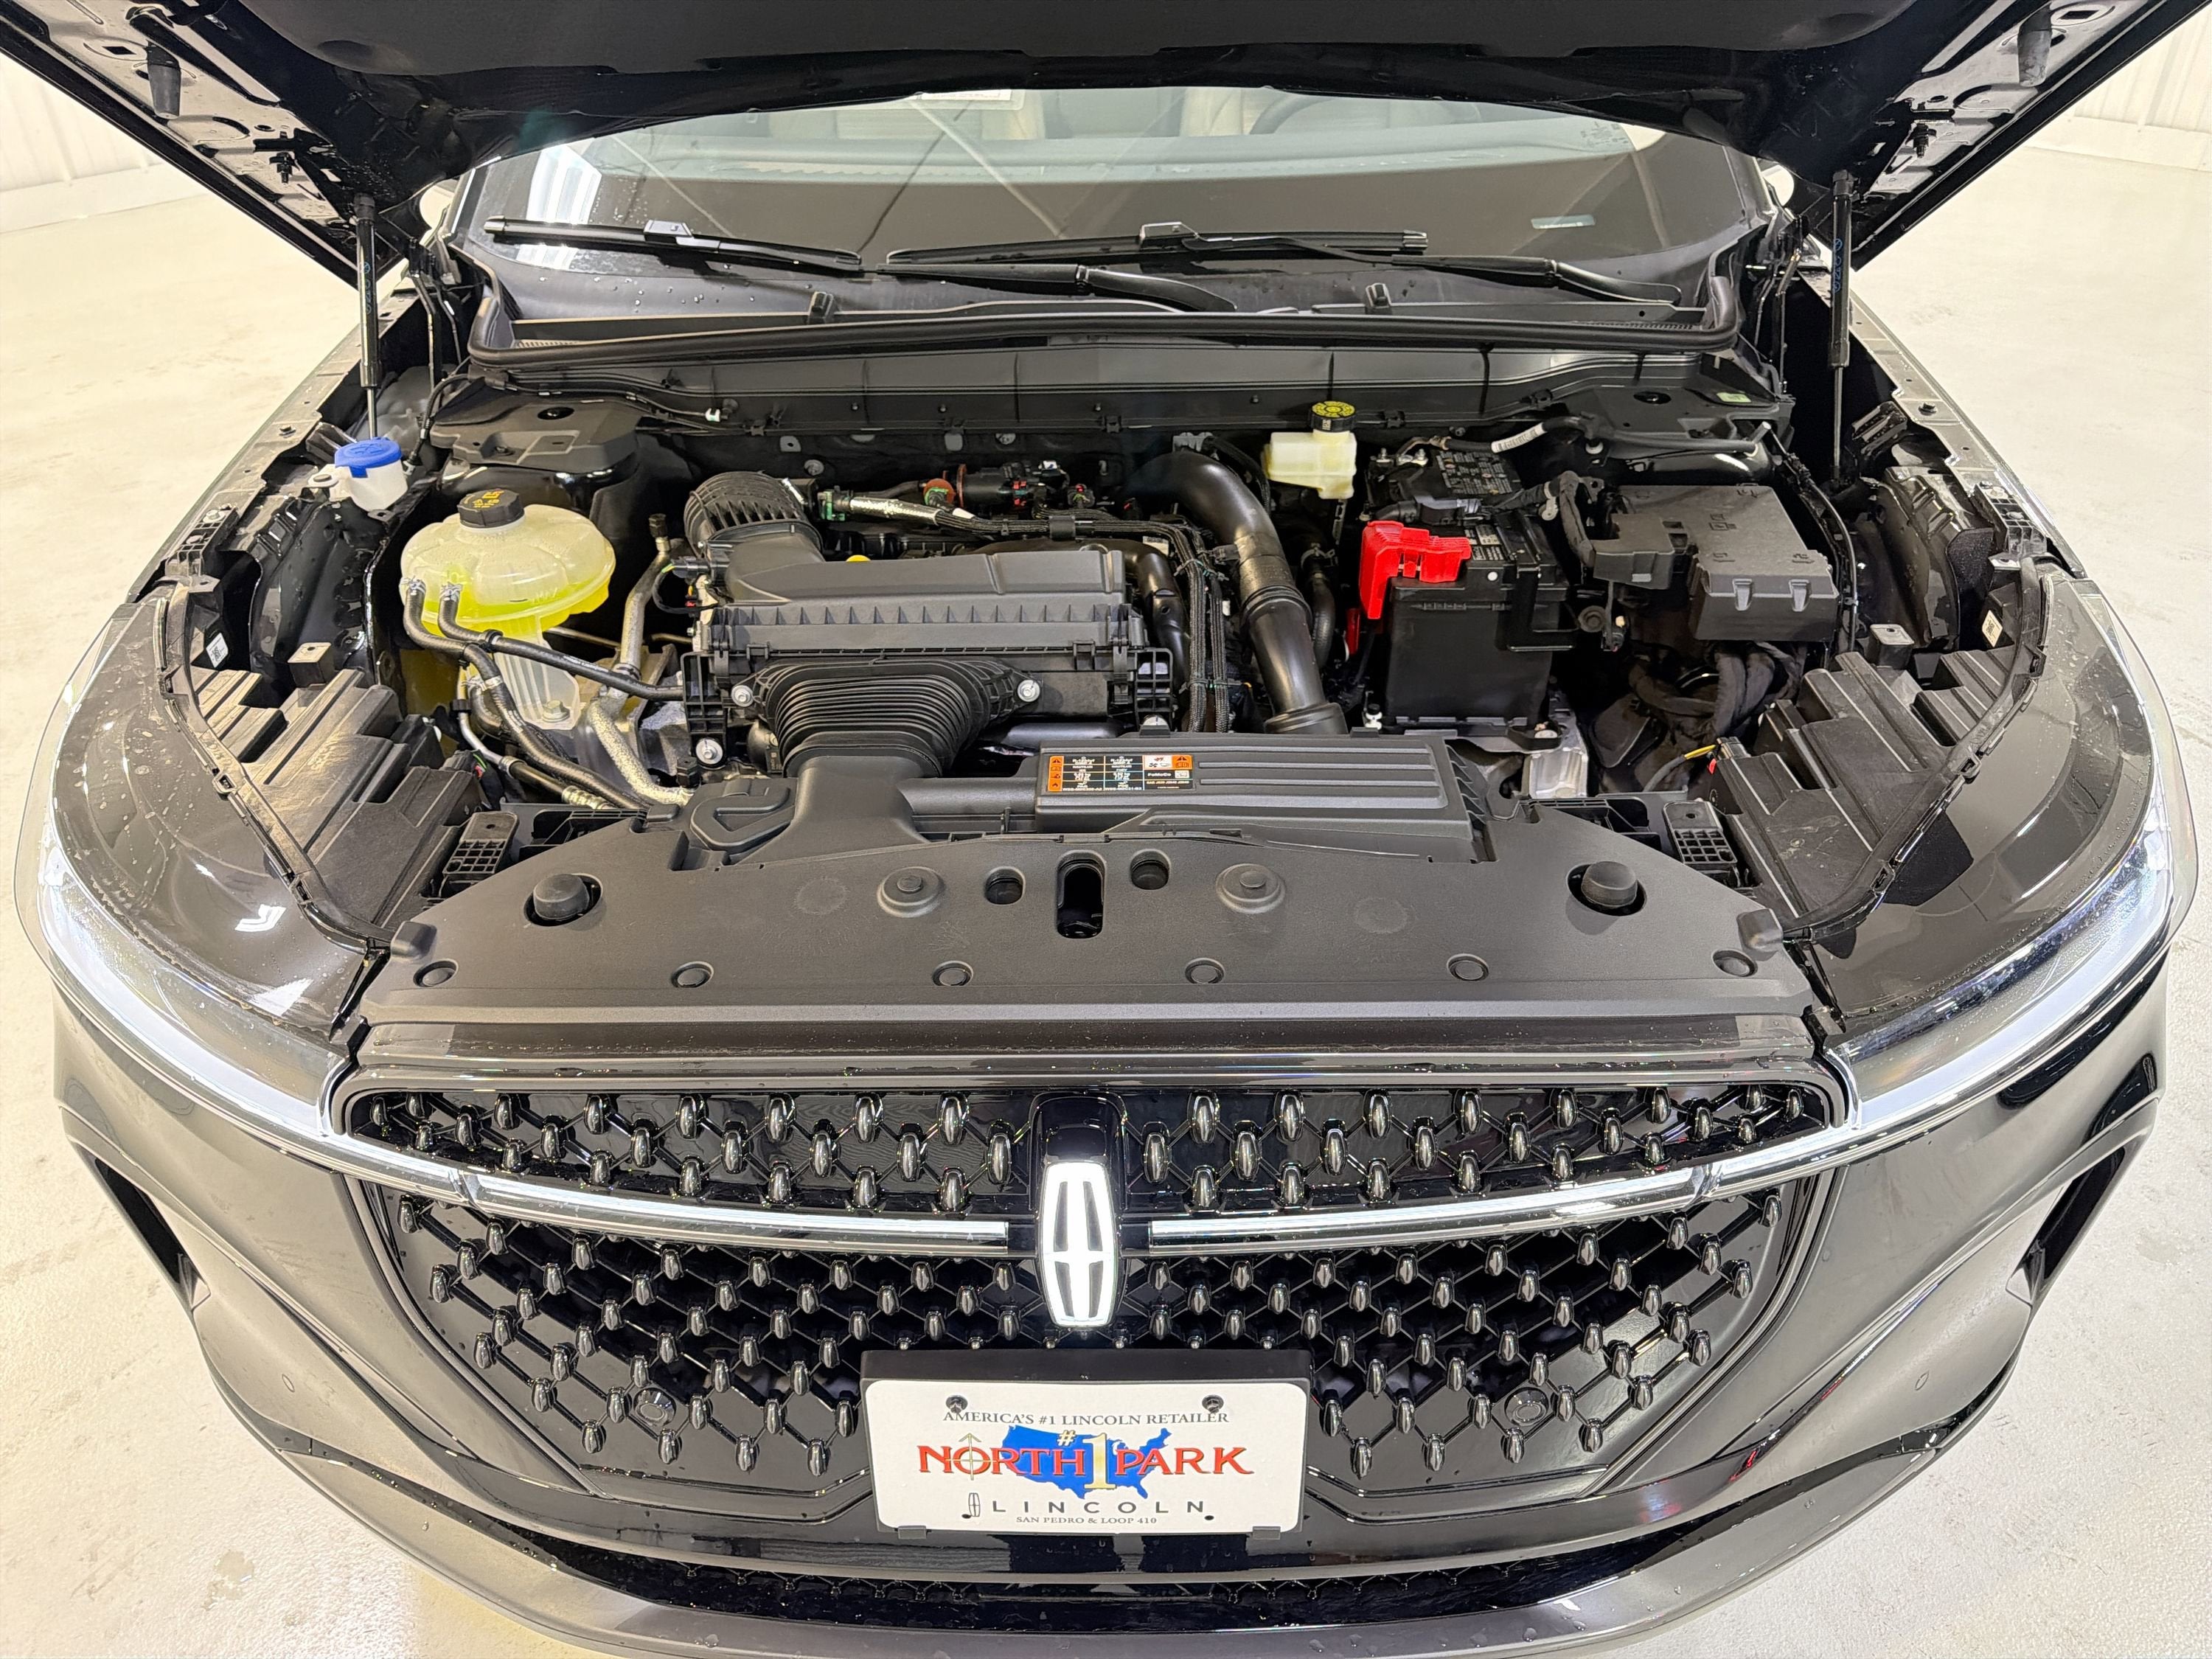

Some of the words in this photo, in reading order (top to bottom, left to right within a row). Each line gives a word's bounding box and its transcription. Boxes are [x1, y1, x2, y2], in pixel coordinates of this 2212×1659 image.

[942, 1411, 1034, 1425] AMERICA'S
[1038, 1414, 1057, 1425] #1
[1061, 1414, 1142, 1425] LINCOLN
[1146, 1412, 1229, 1425] RETAILER
[917, 1444, 1086, 1476] NORTH
[1114, 1446, 1255, 1476] PARK
[992, 1500, 1205, 1514] LINCOLN
